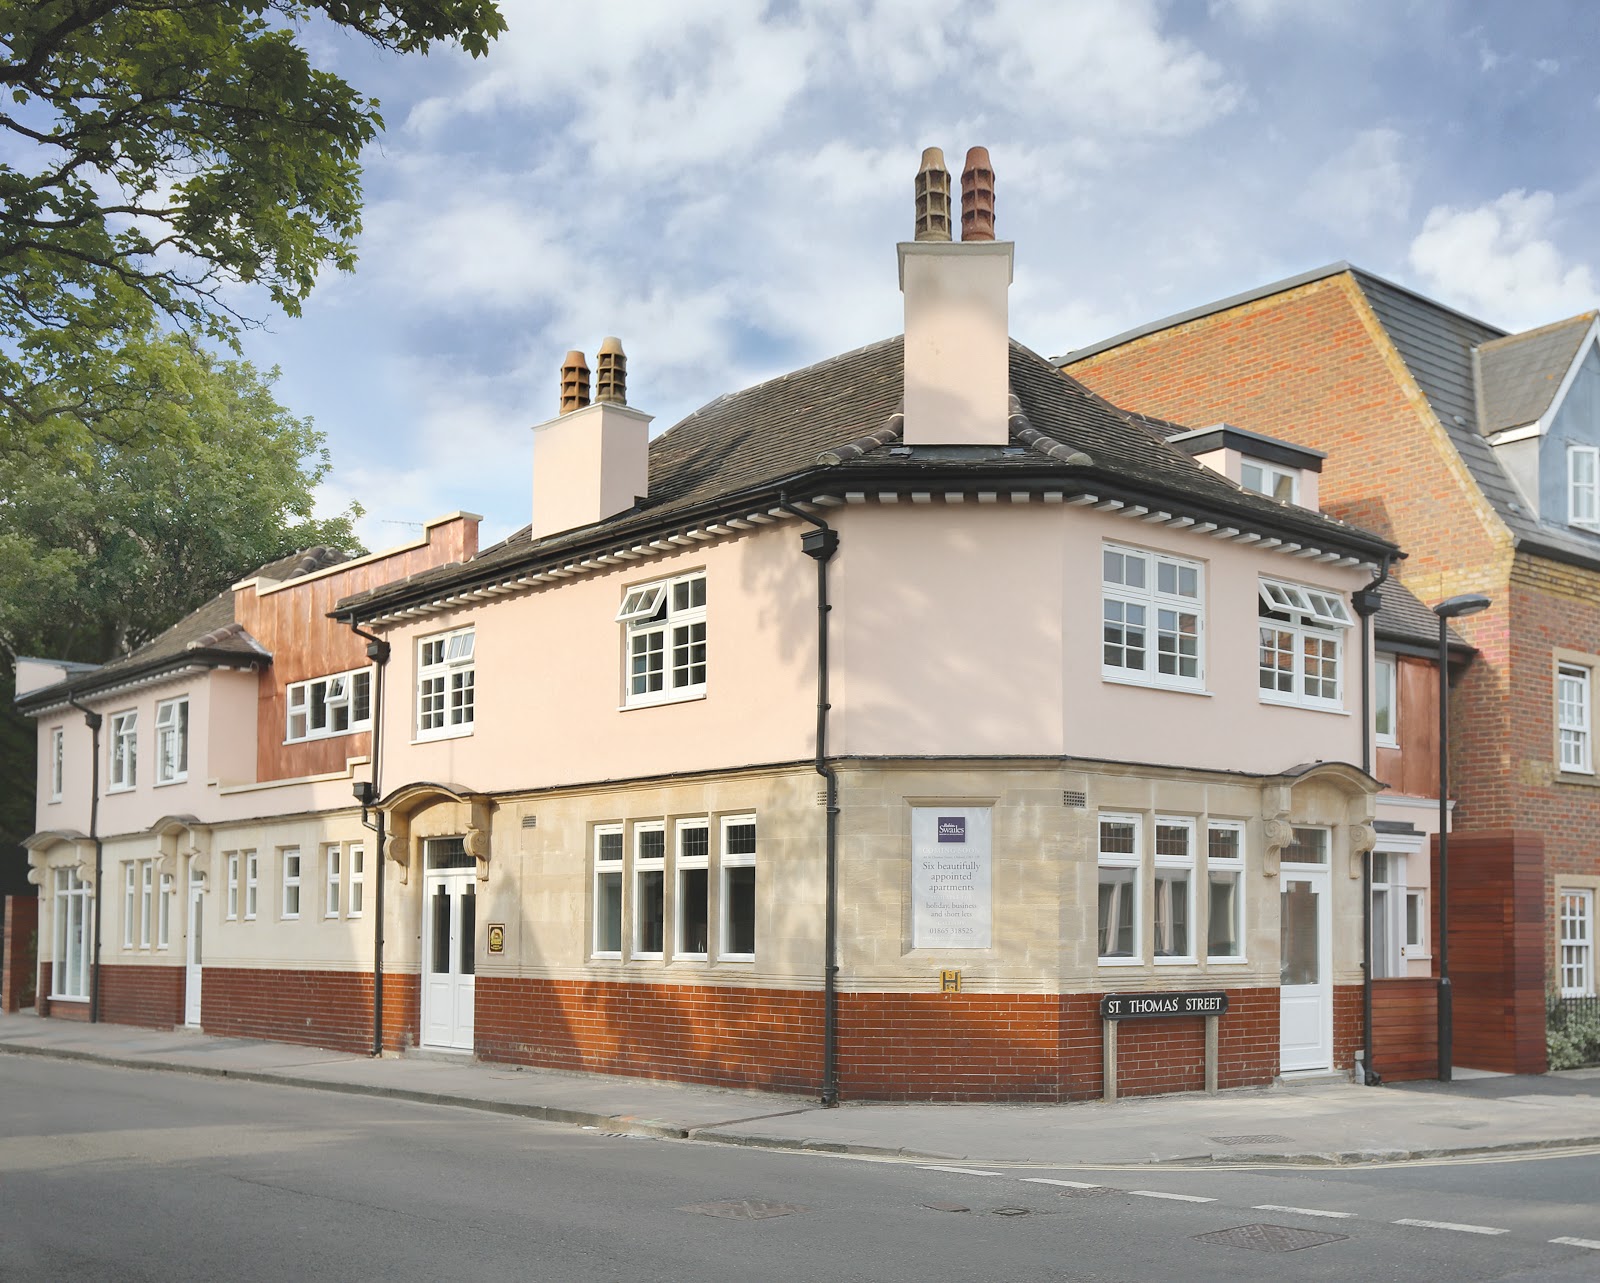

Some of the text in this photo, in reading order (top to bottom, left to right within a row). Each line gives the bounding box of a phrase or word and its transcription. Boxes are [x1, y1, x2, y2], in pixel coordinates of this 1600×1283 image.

[922, 862, 980, 872] Six beautifully
[930, 872, 972, 882] appointed
[928, 885, 974, 893] apartments
[1186, 998, 1222, 1010] STREET
